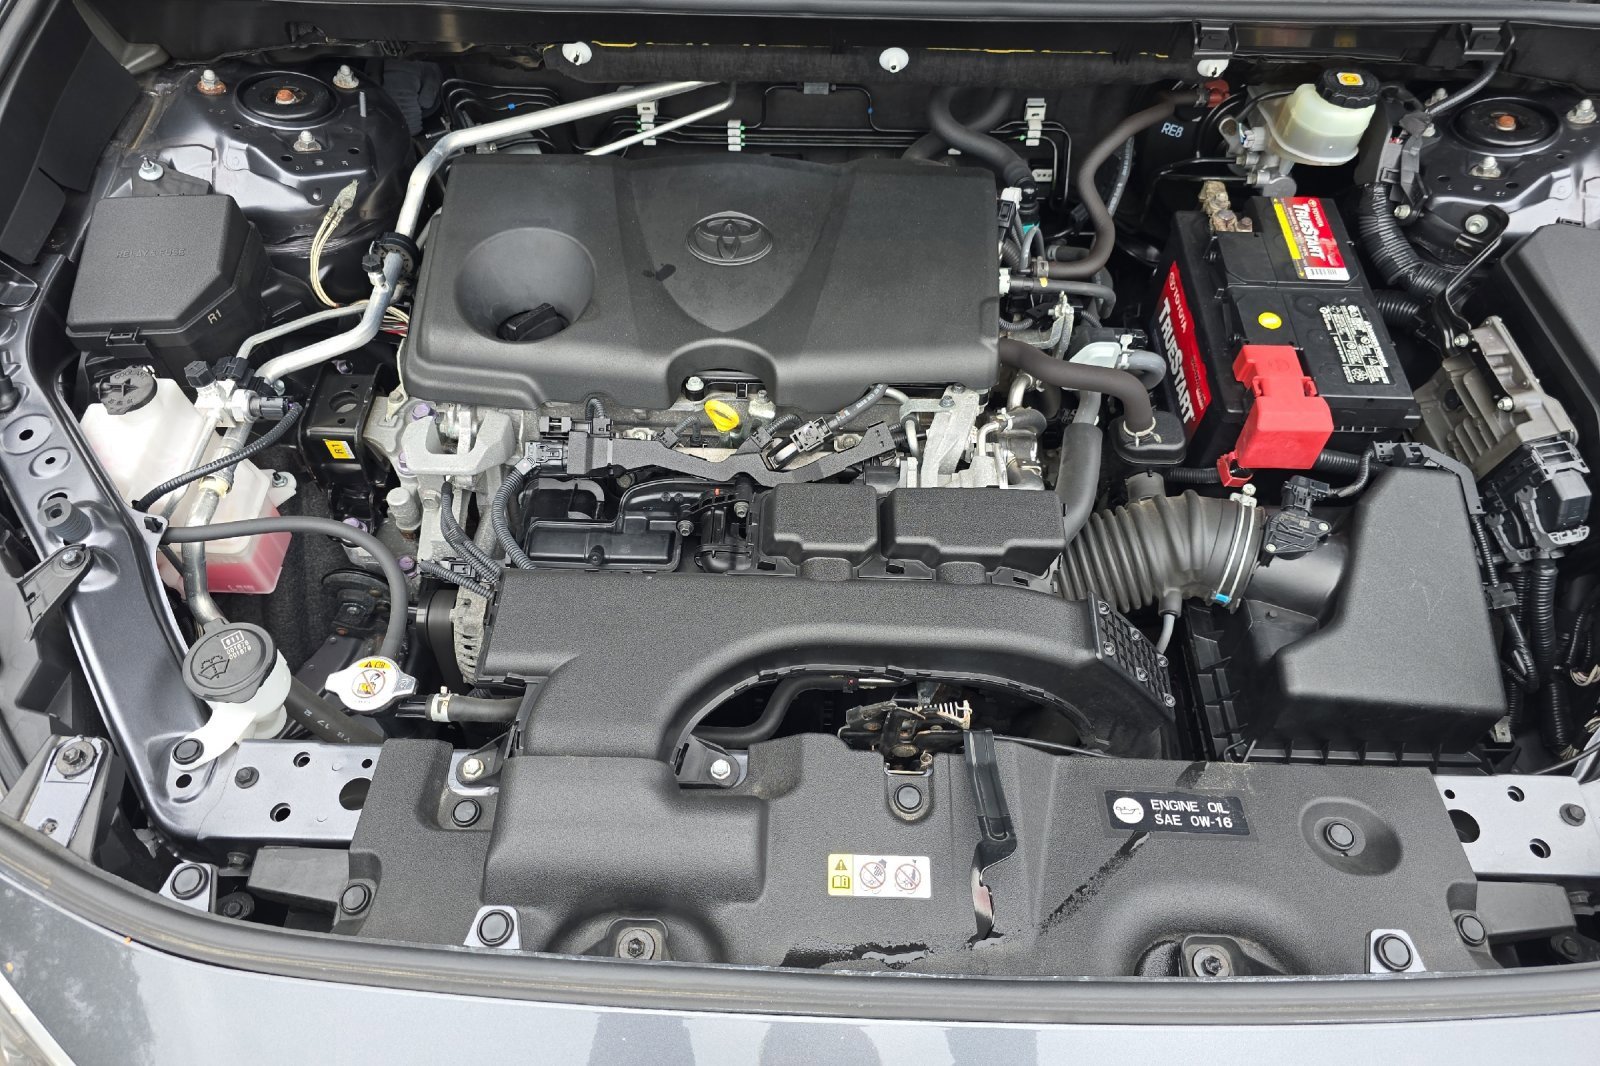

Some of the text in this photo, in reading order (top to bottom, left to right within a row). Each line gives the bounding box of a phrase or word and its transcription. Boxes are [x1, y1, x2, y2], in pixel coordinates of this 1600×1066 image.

[1161, 122, 1184, 138] RE8
[207, 309, 222, 324] R1
[1150, 799, 1230, 814] ENGINE OIL
[1154, 814, 1233, 829] SAE 0W-16
